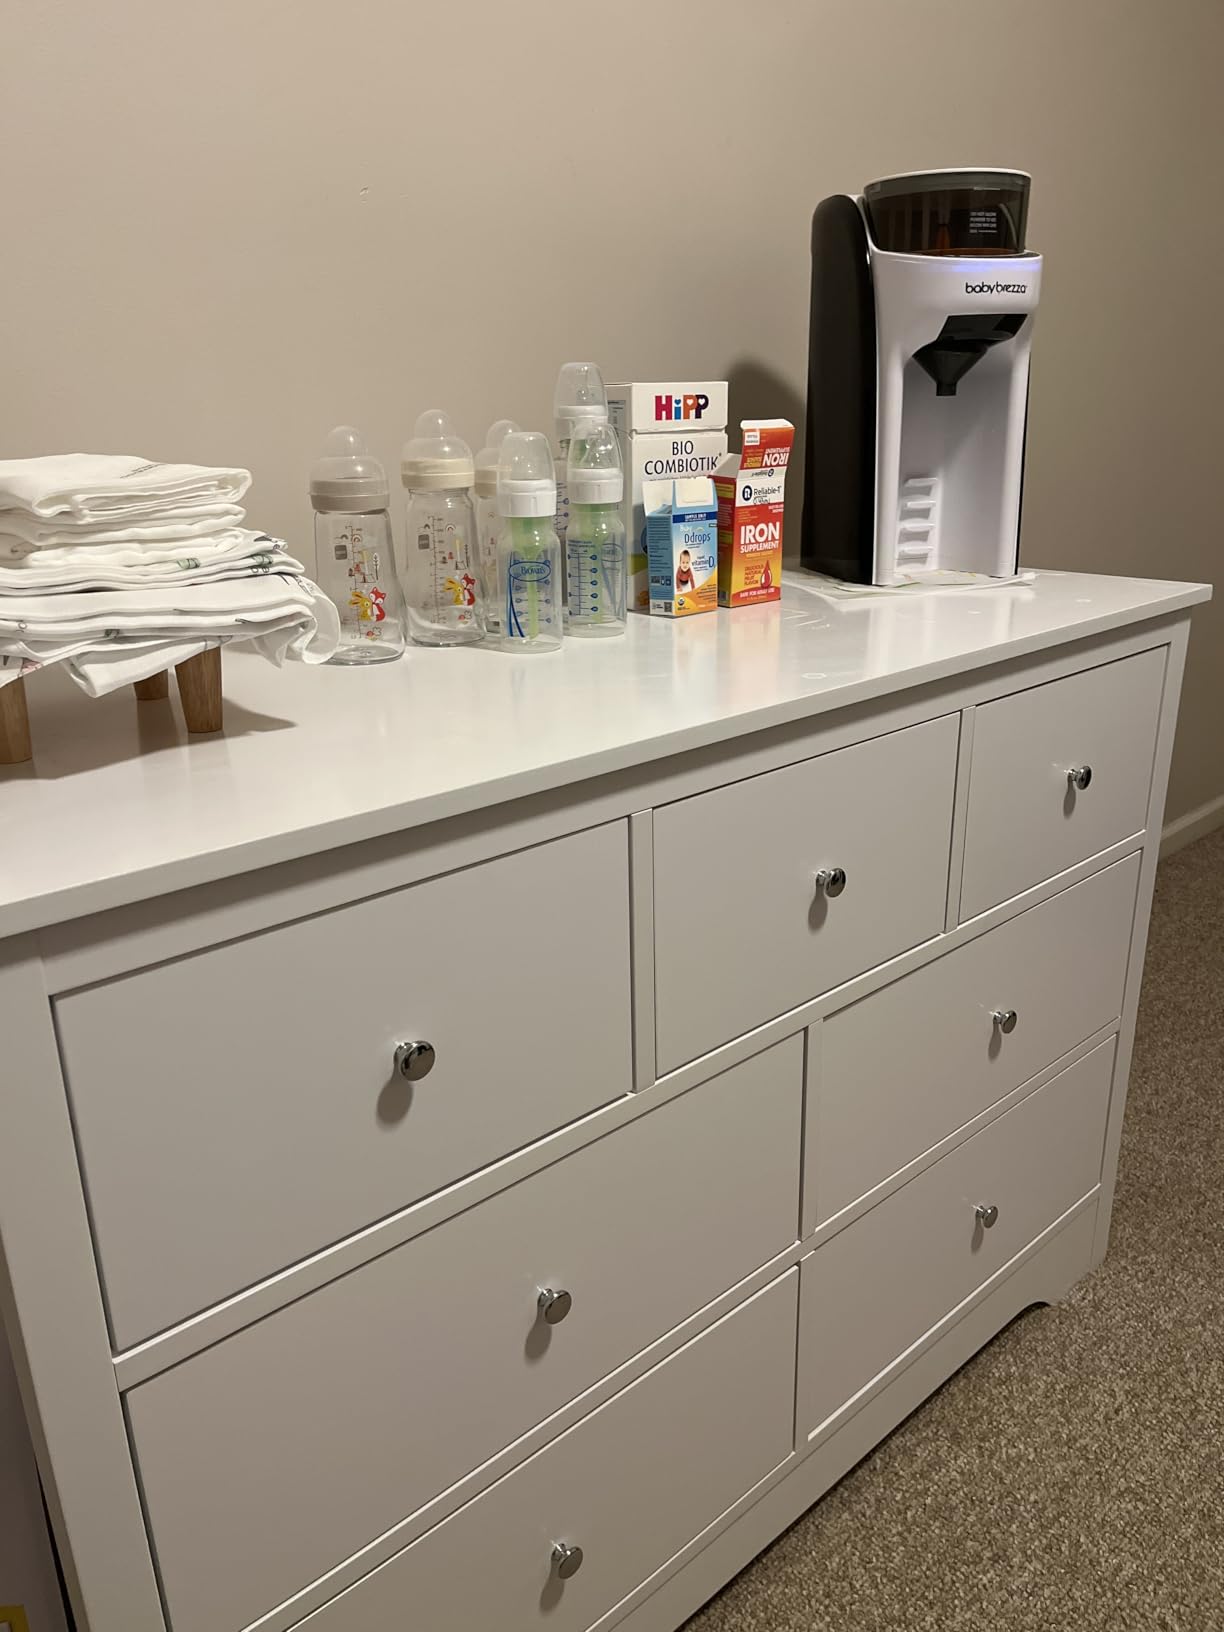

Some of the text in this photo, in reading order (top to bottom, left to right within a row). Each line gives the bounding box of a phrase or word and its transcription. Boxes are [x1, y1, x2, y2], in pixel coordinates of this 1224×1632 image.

[655, 394, 709, 421] HiPP
[672, 440, 694, 456] BIO
[644, 456, 719, 475] COMBIOTIK
[762, 453, 790, 467] IRON
[740, 521, 780, 545] IRON
[740, 541, 780, 553] SUPPLEMENT
